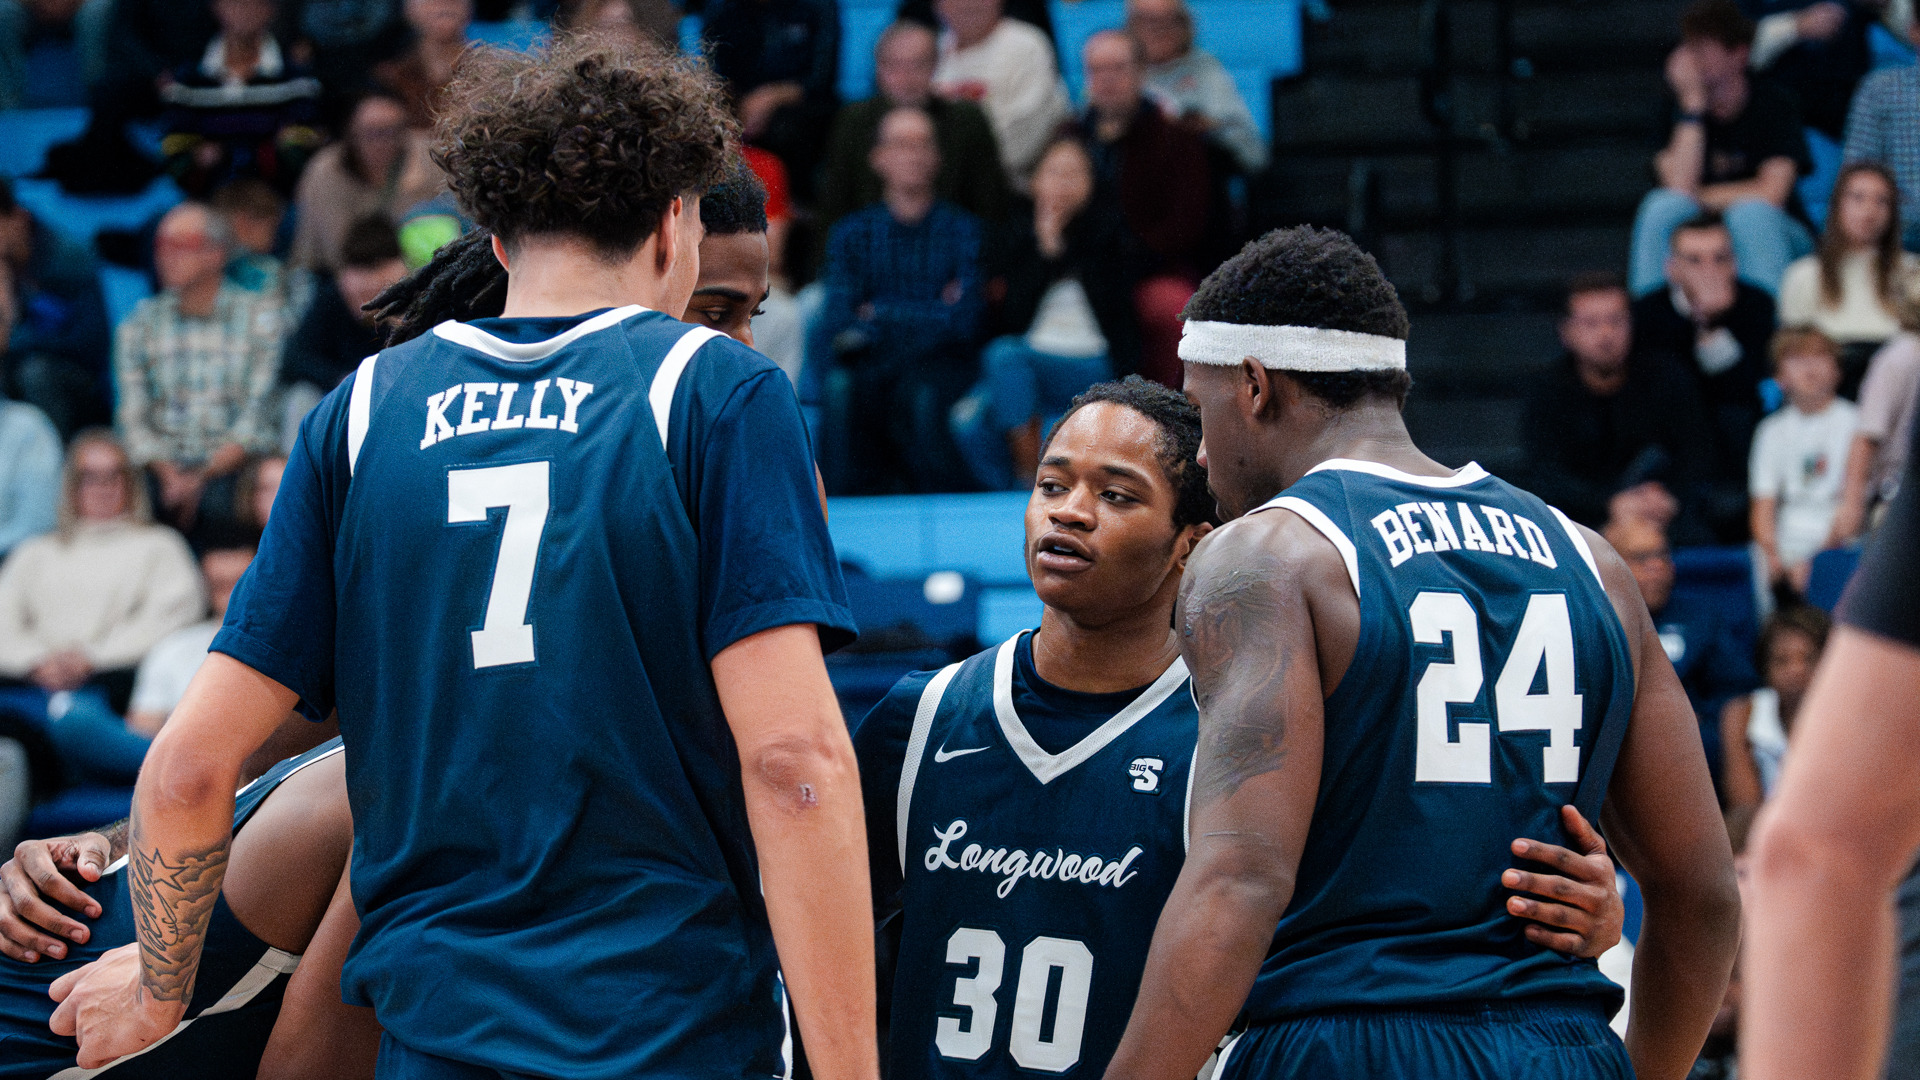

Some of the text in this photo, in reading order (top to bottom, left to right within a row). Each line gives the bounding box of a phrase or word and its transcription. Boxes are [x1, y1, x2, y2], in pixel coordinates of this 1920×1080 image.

[420, 377, 594, 450] KELLY
[447, 460, 550, 669] 7
[1370, 501, 1558, 570] BENARD
[1408, 591, 1583, 783] 24
[1129, 763, 1147, 772] BIG
[924, 819, 1144, 899] Longwood
[934, 927, 1094, 1073] 30
